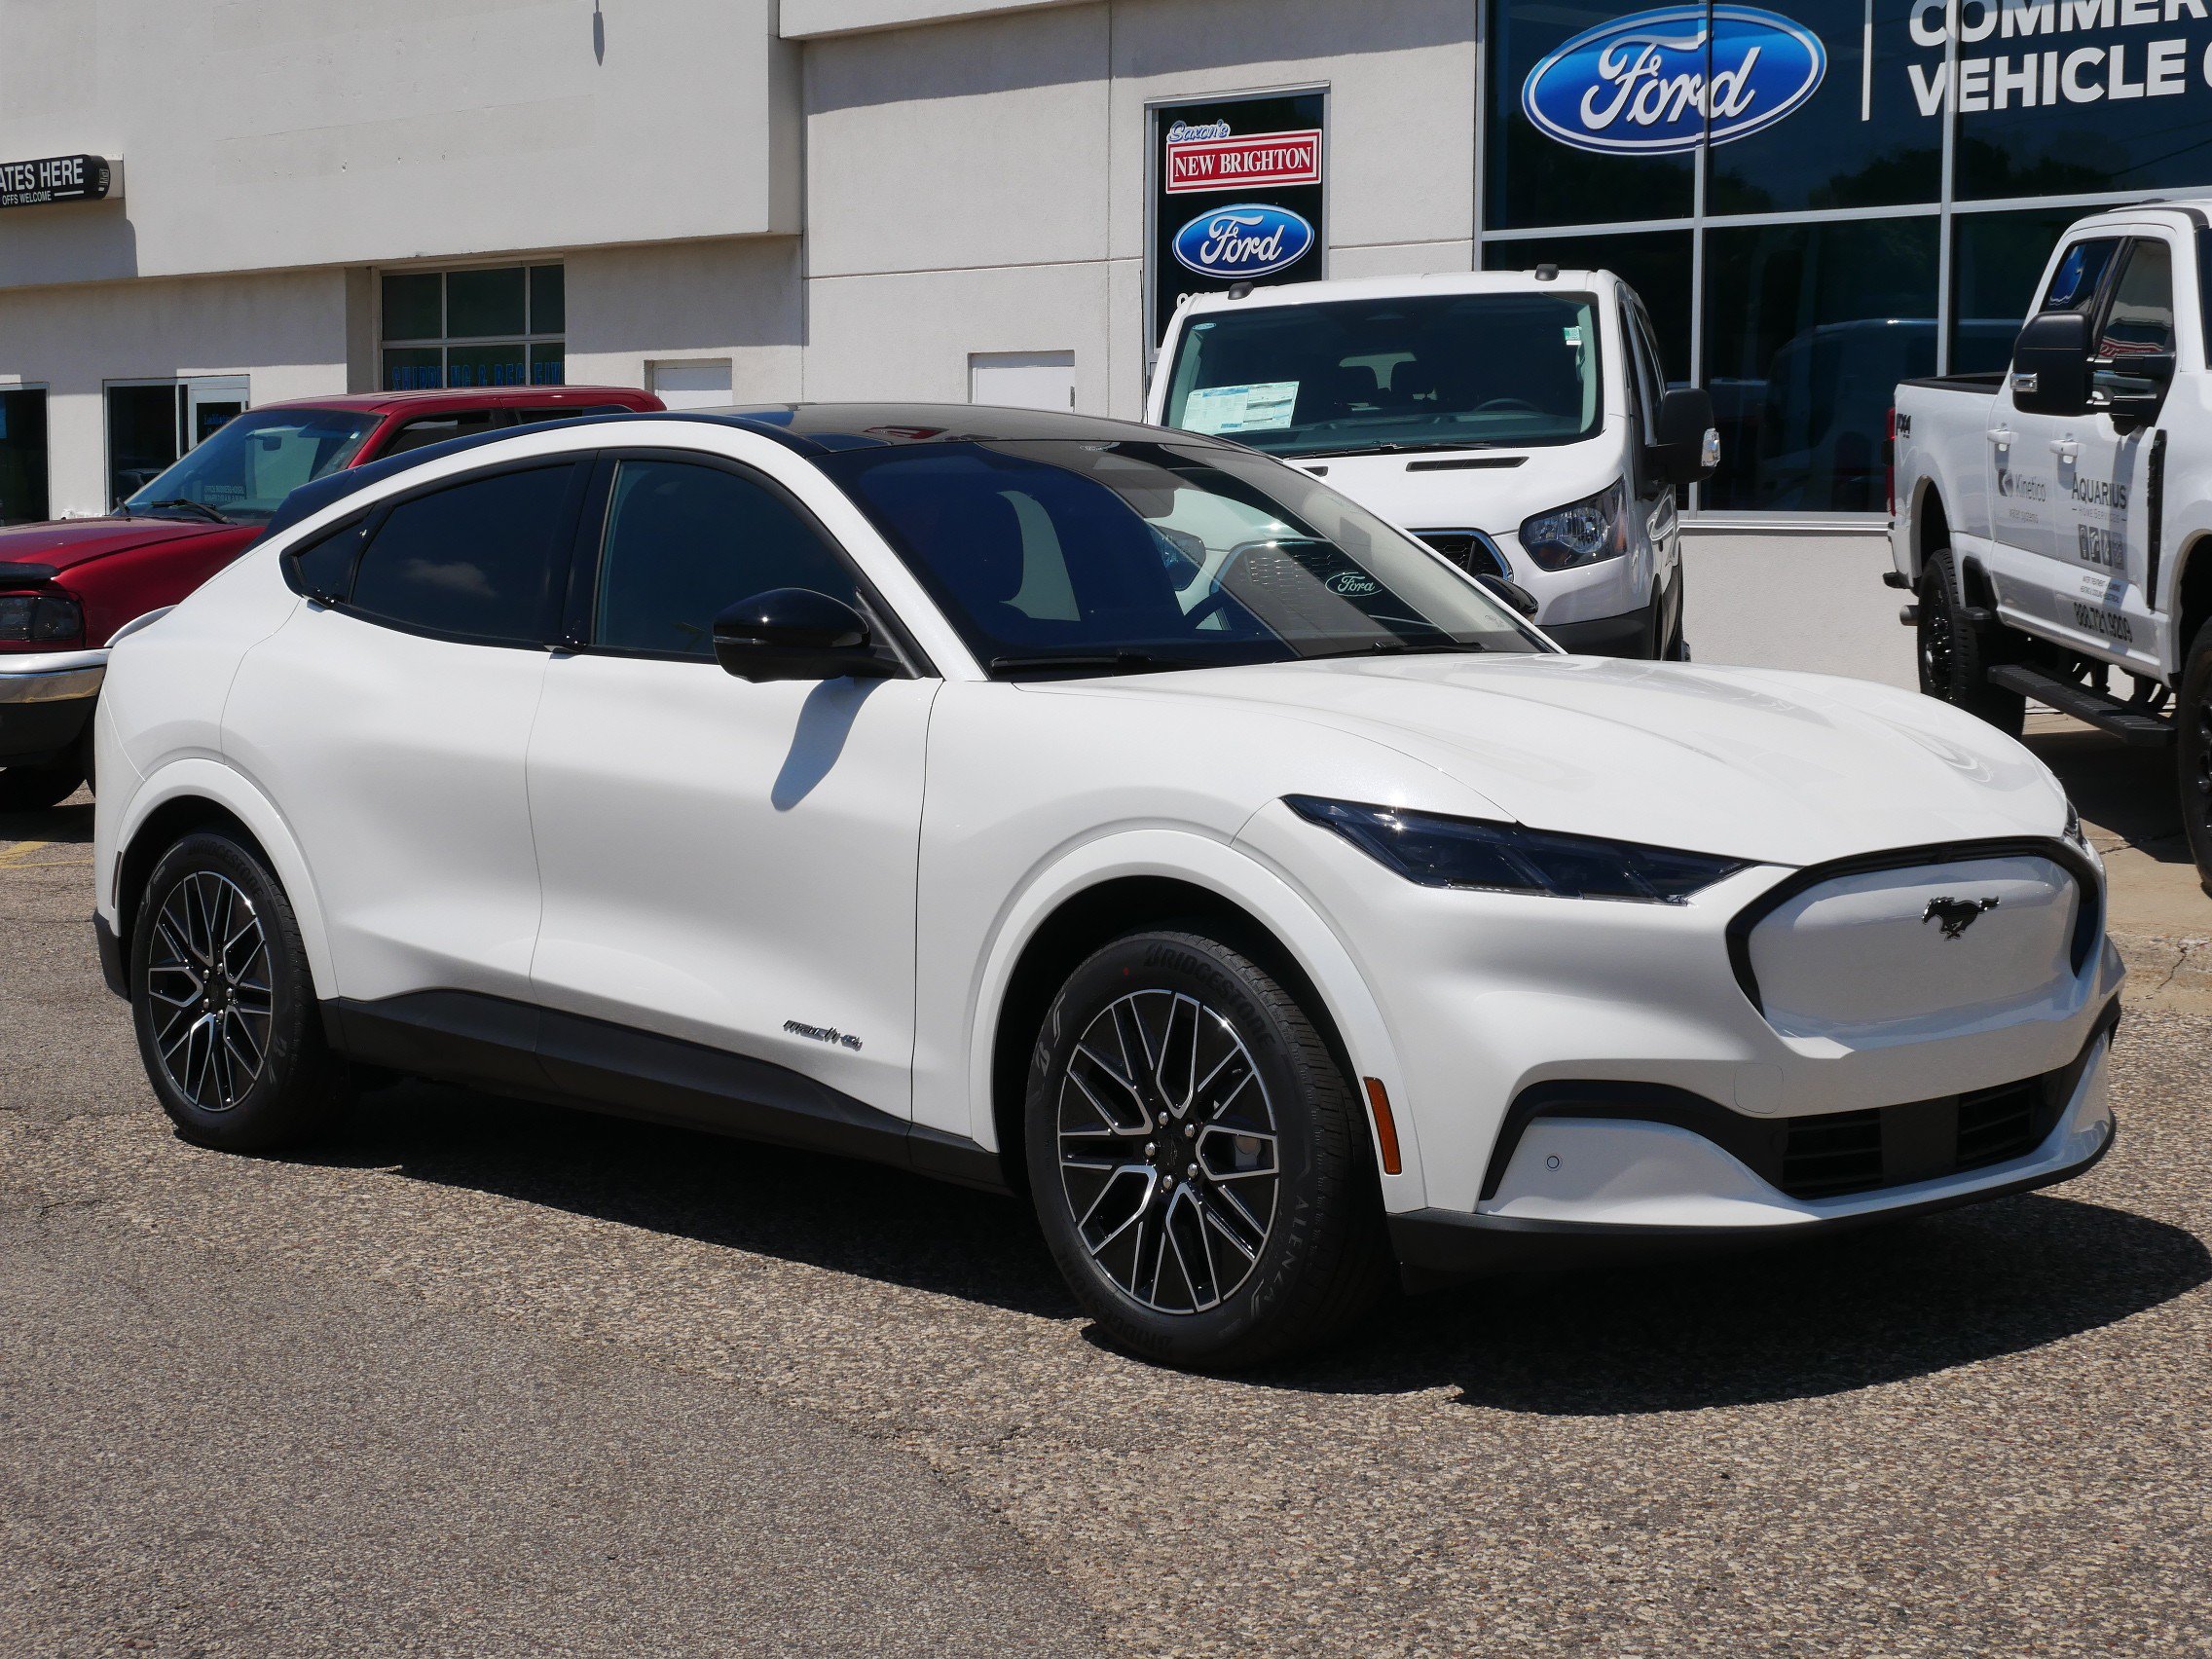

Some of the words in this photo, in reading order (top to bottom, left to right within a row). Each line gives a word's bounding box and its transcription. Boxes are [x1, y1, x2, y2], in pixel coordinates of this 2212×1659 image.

[1579, 30, 1761, 130] Ford
[1907, 38, 2187, 117] VEHICLE
[1167, 120, 1230, 142] Saxon's
[39, 158, 84, 188] HERE
[1174, 154, 1216, 177] NEW
[1219, 146, 1311, 174] BRIGHTON
[2, 193, 18, 205] OFFS
[19, 190, 53, 203] WELCOME
[1200, 214, 1285, 265] Ford
[2071, 471, 2127, 509] AQUARIUS
[1337, 575, 1375, 593] Ford
[1142, 941, 1277, 1046] BRIDGESTONE
[1262, 1193, 1310, 1305] ALENZA
